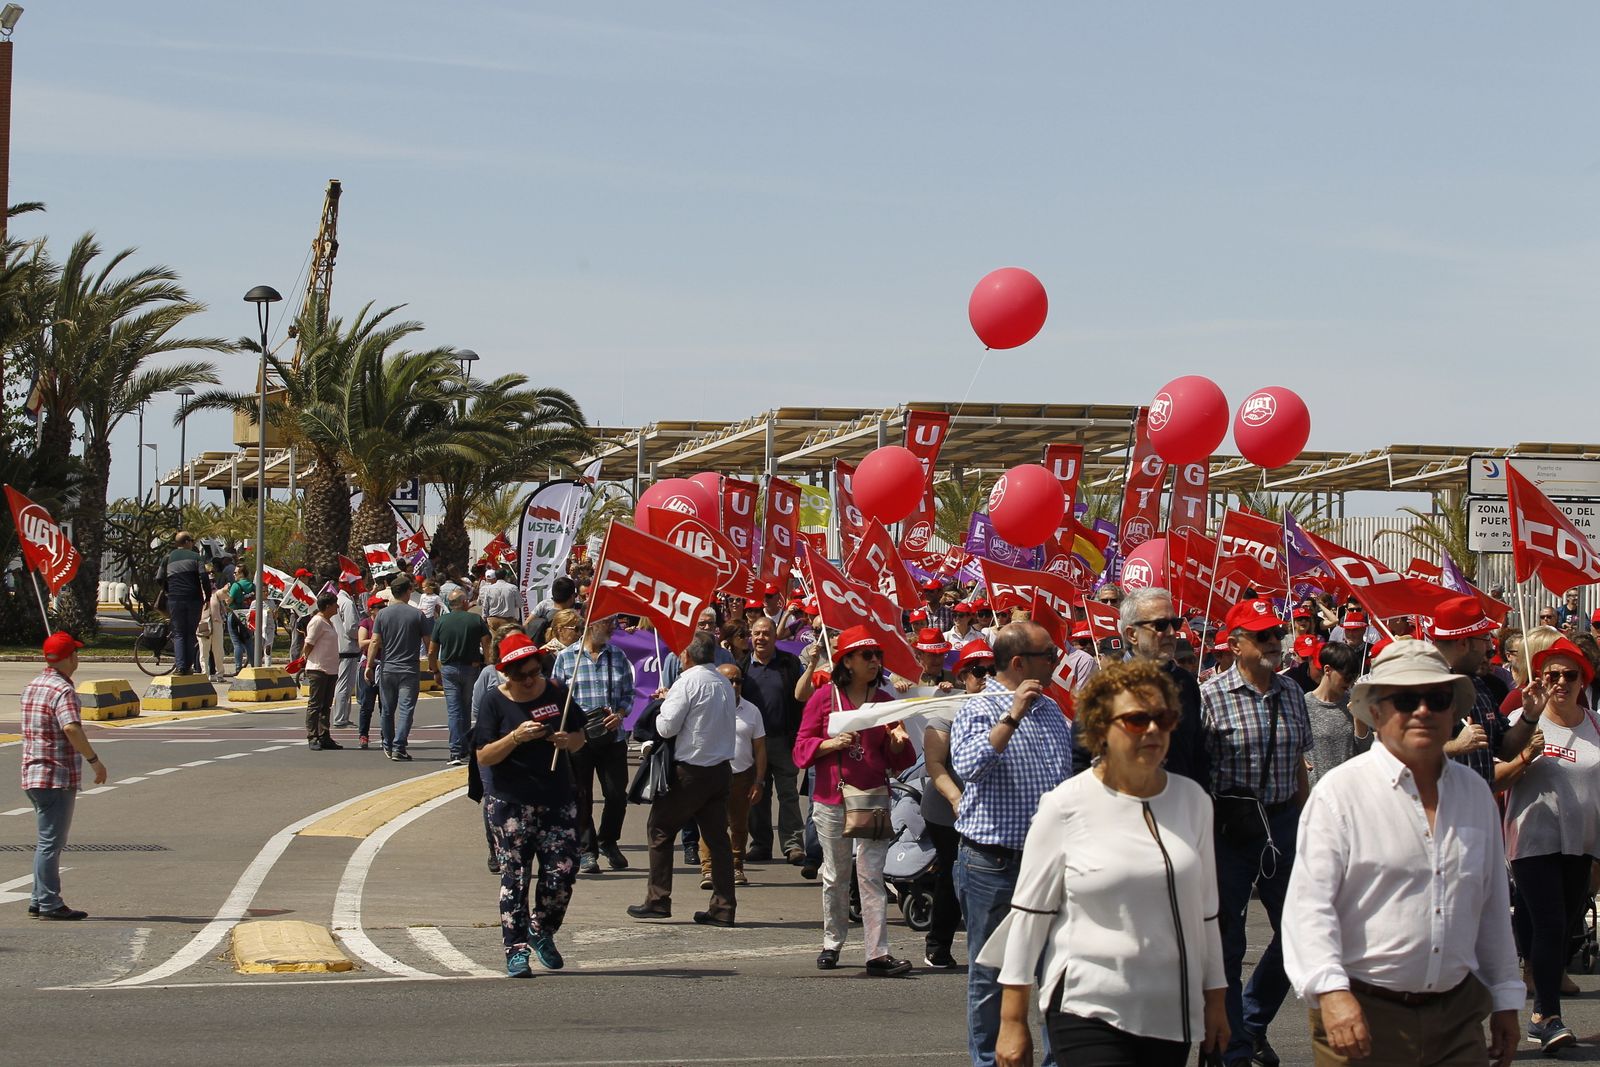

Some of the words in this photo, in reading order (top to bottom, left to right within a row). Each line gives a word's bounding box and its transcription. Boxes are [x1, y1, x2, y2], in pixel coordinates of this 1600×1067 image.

[1150, 399, 1170, 414] UGT
[1245, 397, 1271, 413] UGT
[1477, 505, 1505, 514] ZONA
[1577, 507, 1595, 516] DEL
[23, 513, 60, 553] UGT
[729, 492, 751, 564] UG
[771, 491, 794, 577] UGT
[910, 526, 929, 539] UGT
[1127, 521, 1150, 536] UGT
[521, 541, 535, 588] ANDALUZA
[1124, 564, 1149, 581] UGT
[599, 560, 703, 628] CCOO
[531, 703, 559, 719] CCOO
[1543, 744, 1575, 759] CCOO
